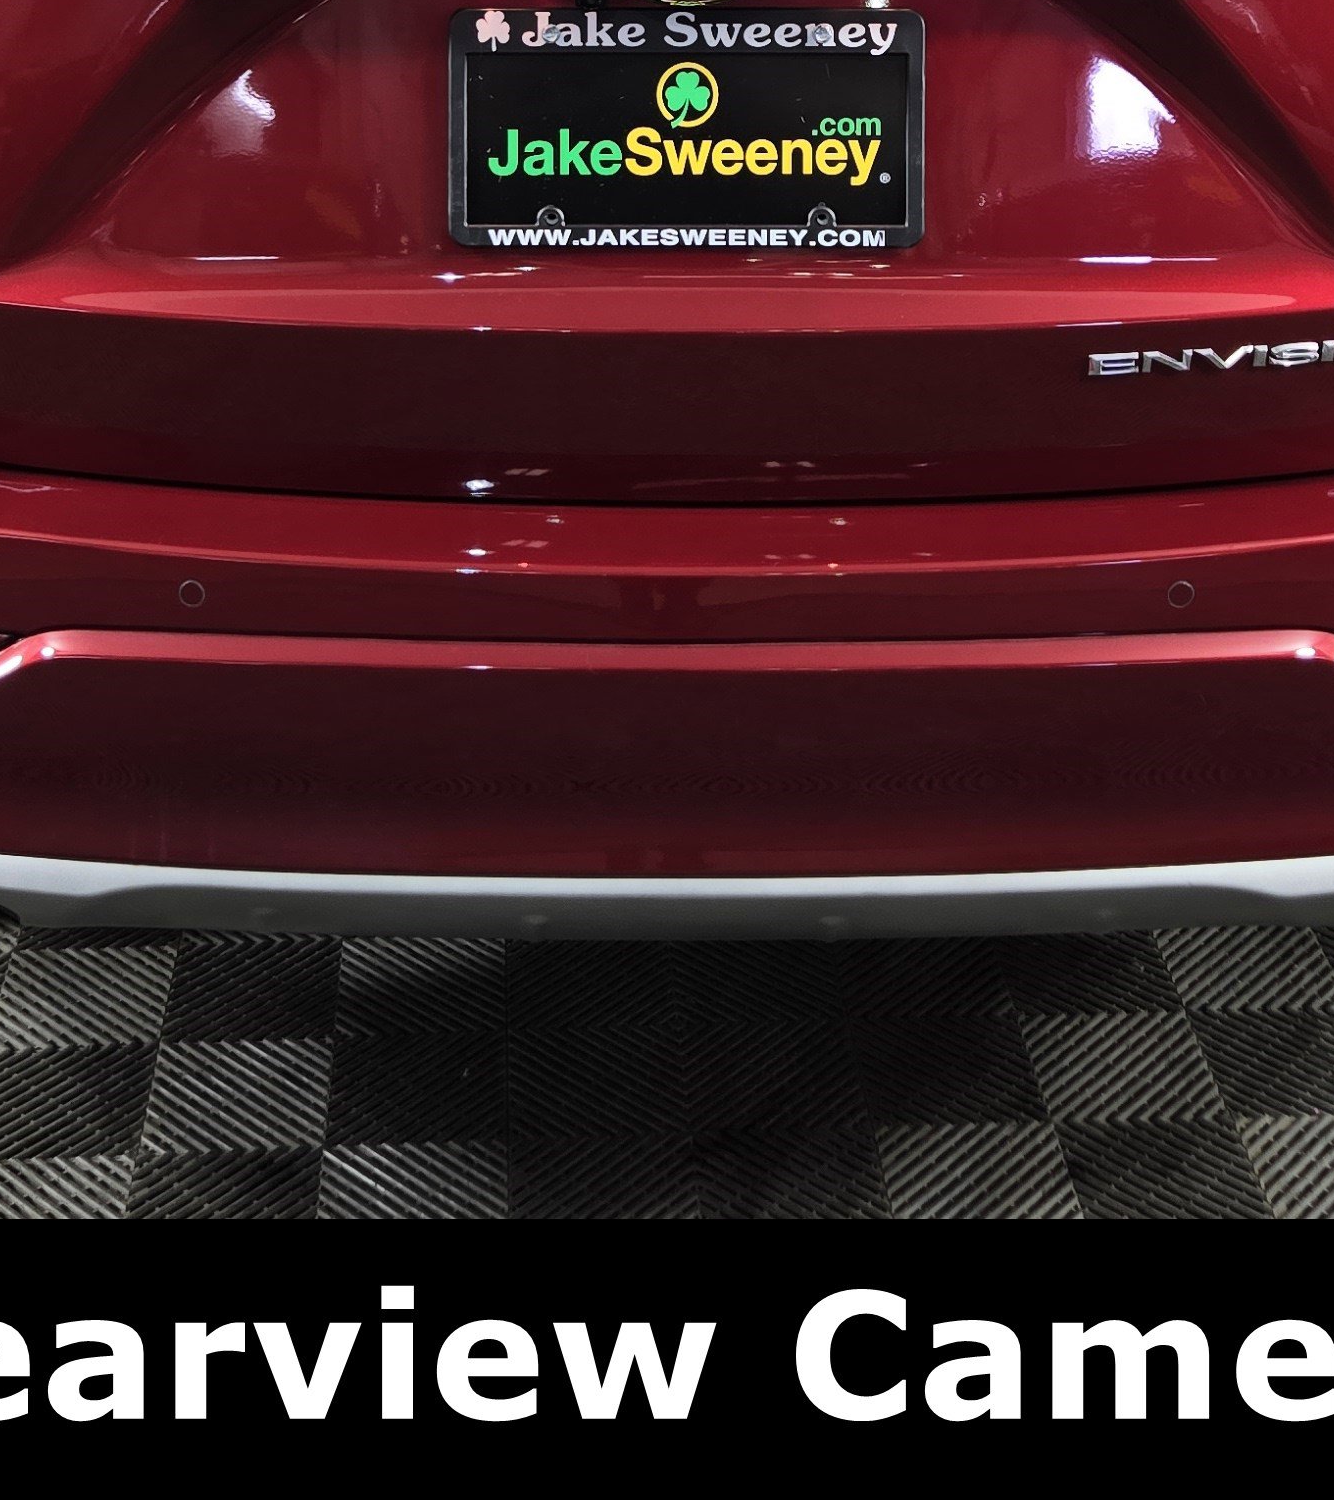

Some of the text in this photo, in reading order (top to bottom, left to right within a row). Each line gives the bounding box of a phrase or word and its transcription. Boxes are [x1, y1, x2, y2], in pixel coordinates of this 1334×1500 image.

[521, 10, 899, 56] Jake Sweeney
[488, 227, 887, 248] WWW.JAKESWEENEY.COM
